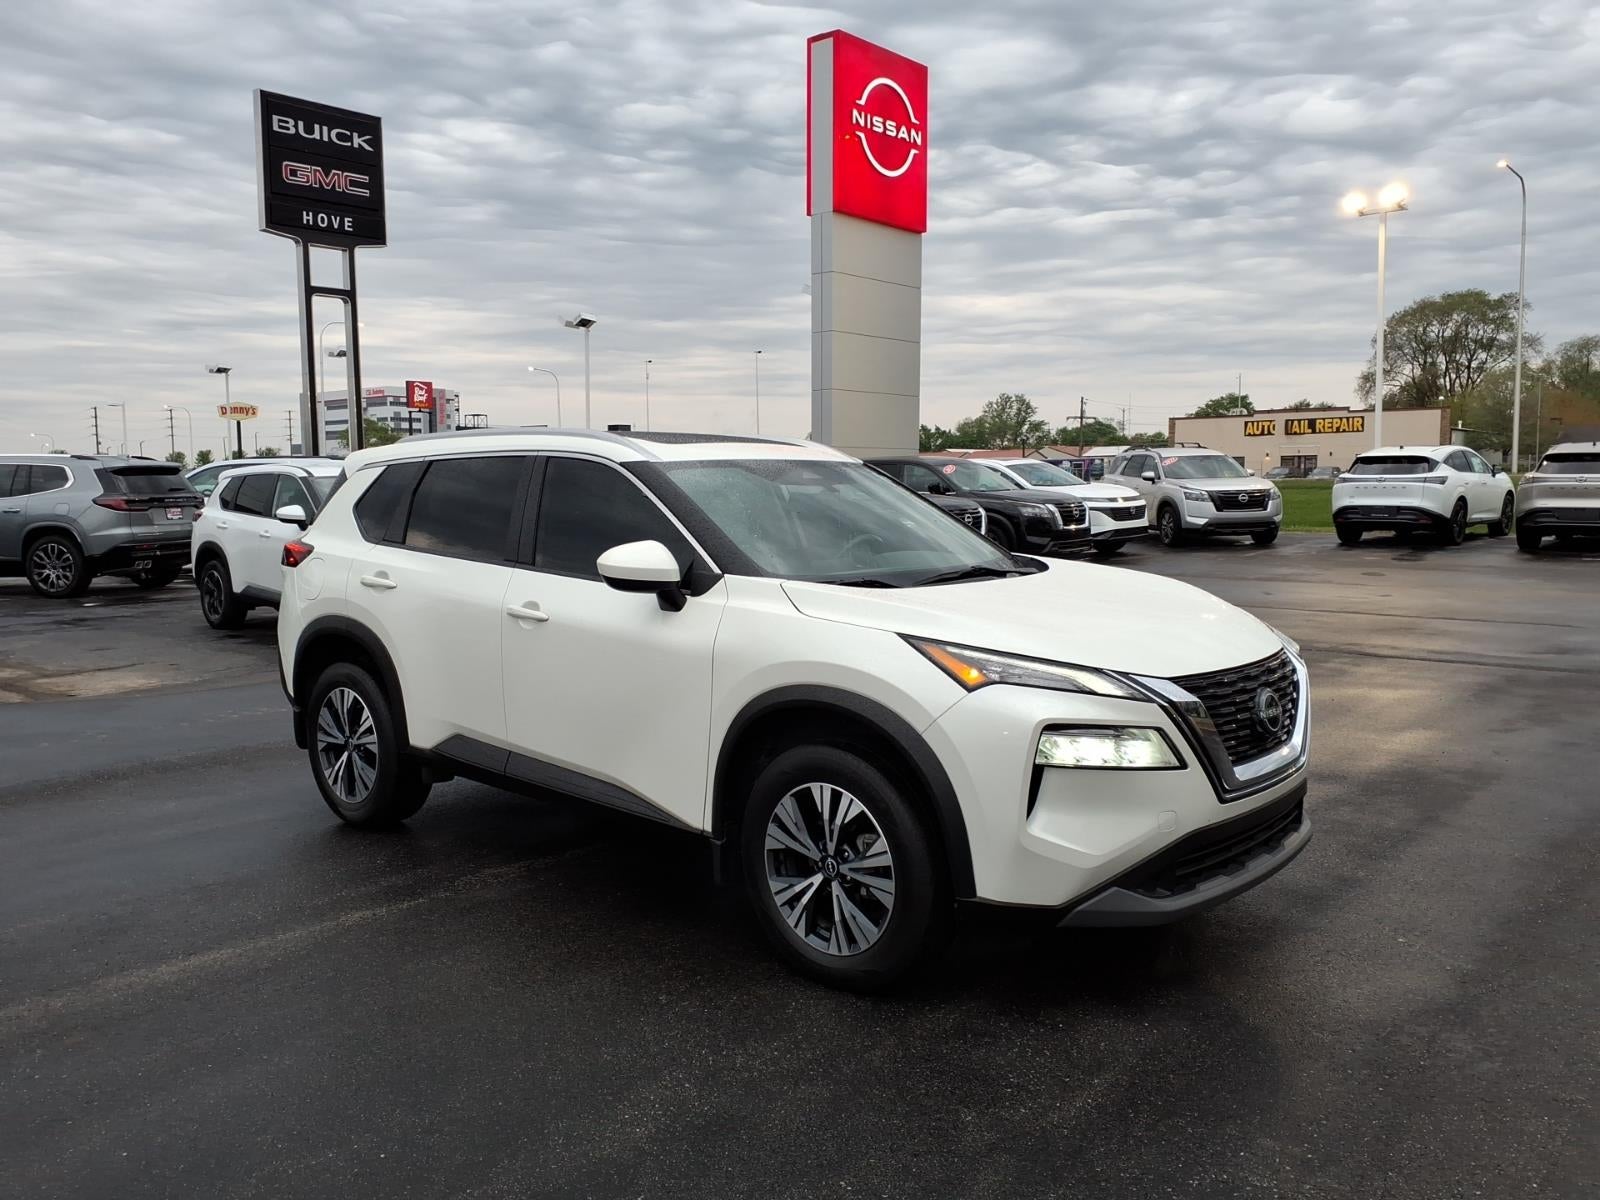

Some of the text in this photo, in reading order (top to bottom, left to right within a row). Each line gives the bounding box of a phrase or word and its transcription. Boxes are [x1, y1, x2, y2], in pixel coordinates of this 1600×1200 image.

[272, 115, 374, 151] BUICK
[852, 108, 922, 145] NISSAN
[282, 161, 370, 197] GMC
[302, 211, 354, 231] HOVE
[220, 405, 257, 417] Dnny's
[1316, 417, 1363, 433] REPAIR
